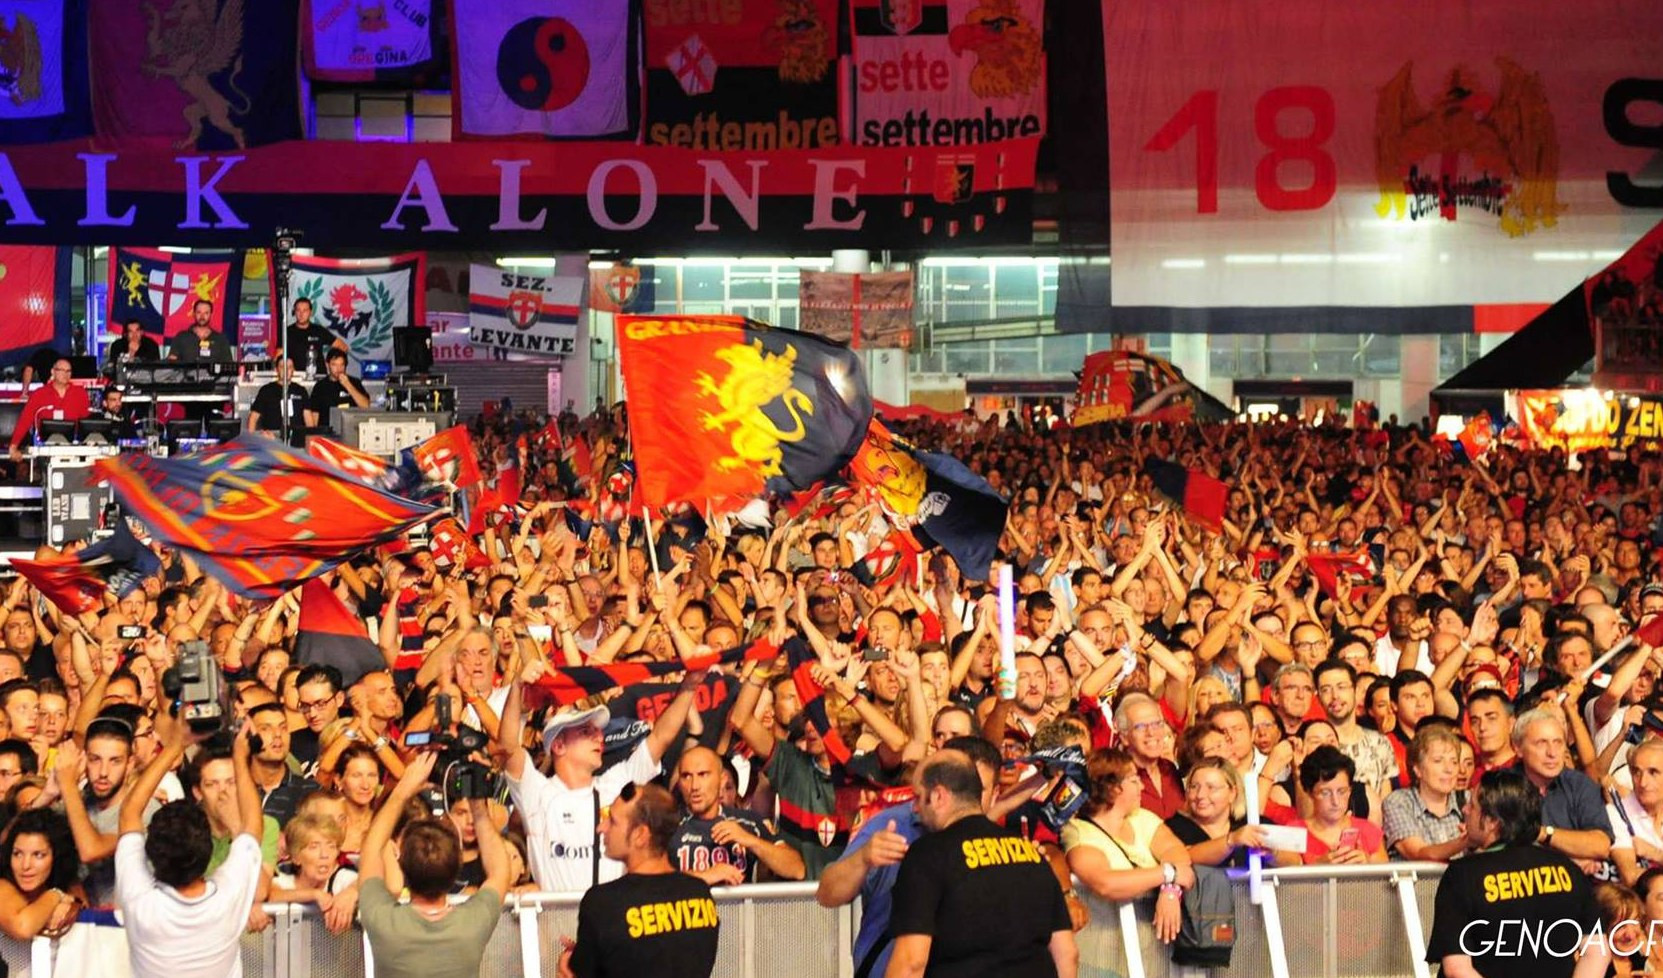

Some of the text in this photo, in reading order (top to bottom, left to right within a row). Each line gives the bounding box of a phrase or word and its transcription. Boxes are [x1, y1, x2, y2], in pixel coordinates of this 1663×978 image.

[393, 0, 427, 28] CLUB
[860, 51, 949, 93] sette
[650, 110, 838, 150] settembre
[863, 107, 1041, 147] settembre
[381, 157, 867, 233] ALONE
[501, 273, 553, 293] SEZ.
[470, 327, 574, 352] LEVANTE
[636, 680, 727, 721] GEOA
[605, 722, 628, 743] and
[677, 844, 747, 873] 1893
[1484, 866, 1572, 903] SERVIZIO
[626, 898, 717, 938] SERVIZIO
